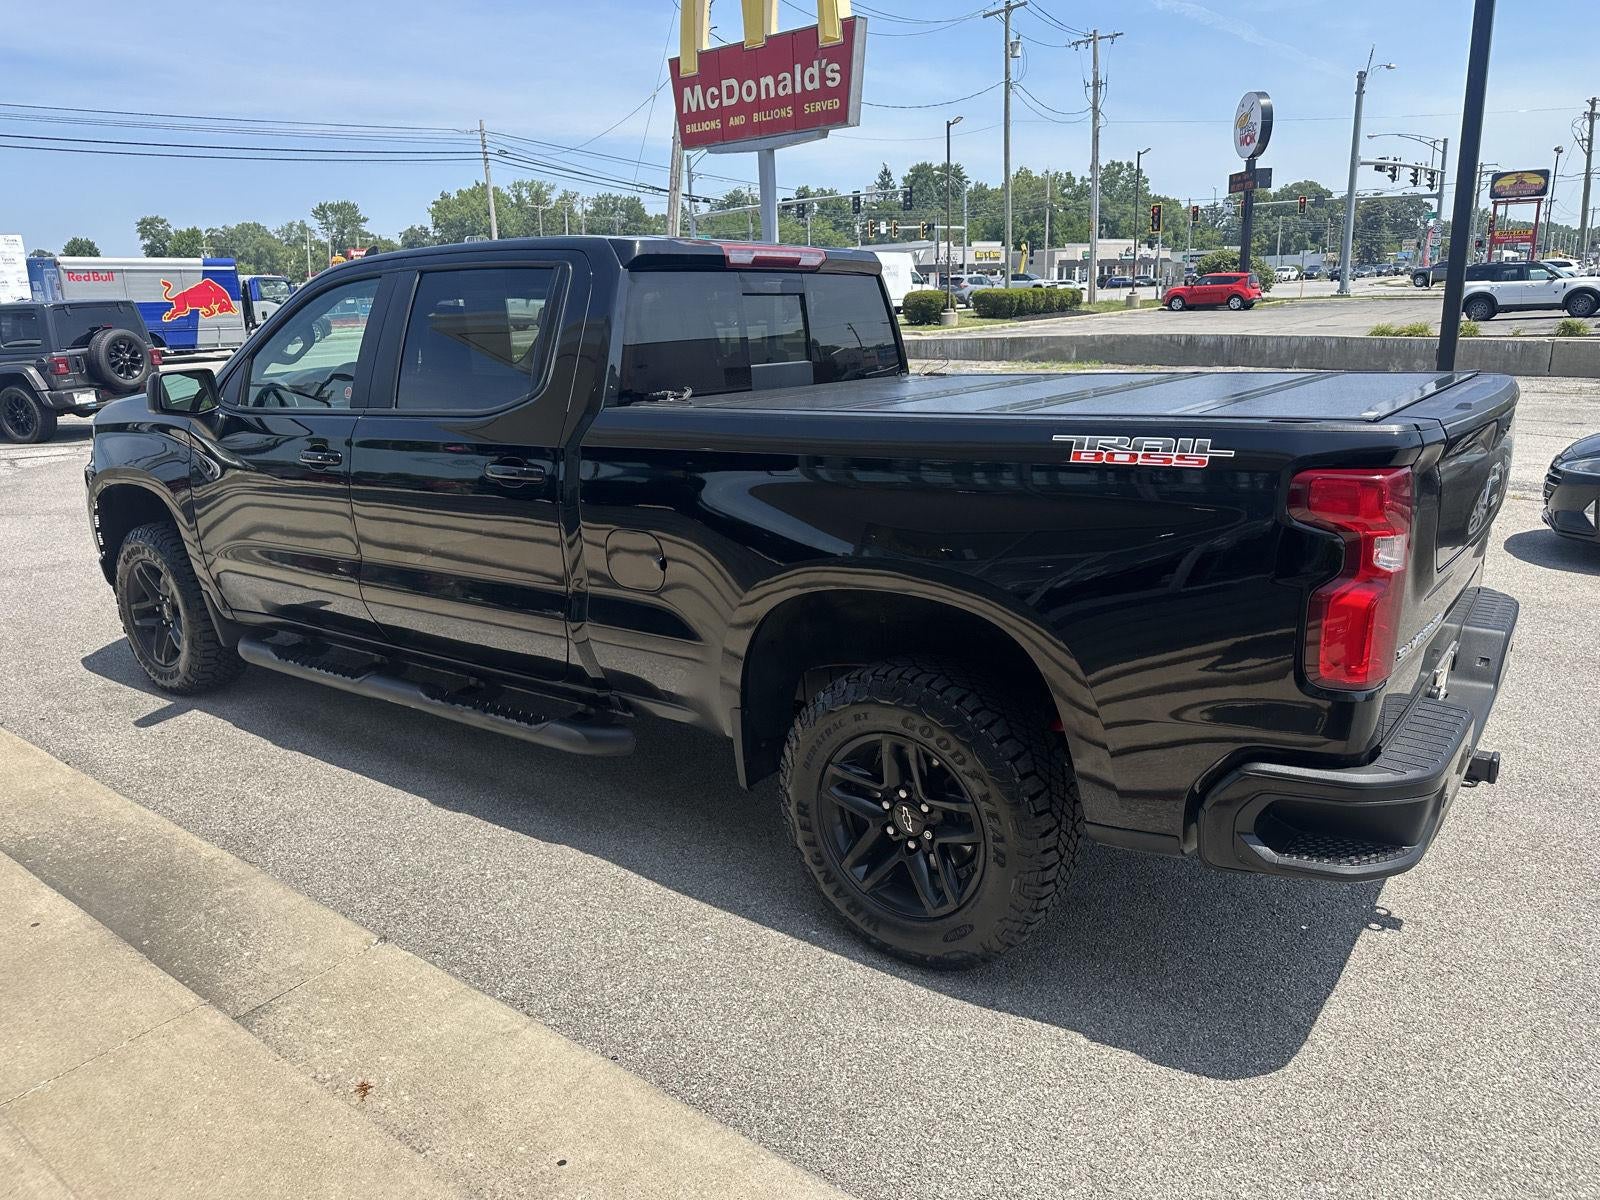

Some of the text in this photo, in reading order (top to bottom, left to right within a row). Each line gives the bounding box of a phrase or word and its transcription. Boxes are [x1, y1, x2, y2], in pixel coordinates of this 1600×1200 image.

[682, 58, 842, 114] McDonald's
[685, 98, 841, 134] BILLIONS AND BILLIONS SERVED
[67, 271, 114, 282] Red Bull
[1052, 434, 1235, 457] TRAIL
[1068, 449, 1209, 468] BOSS
[852, 711, 870, 722] RT
